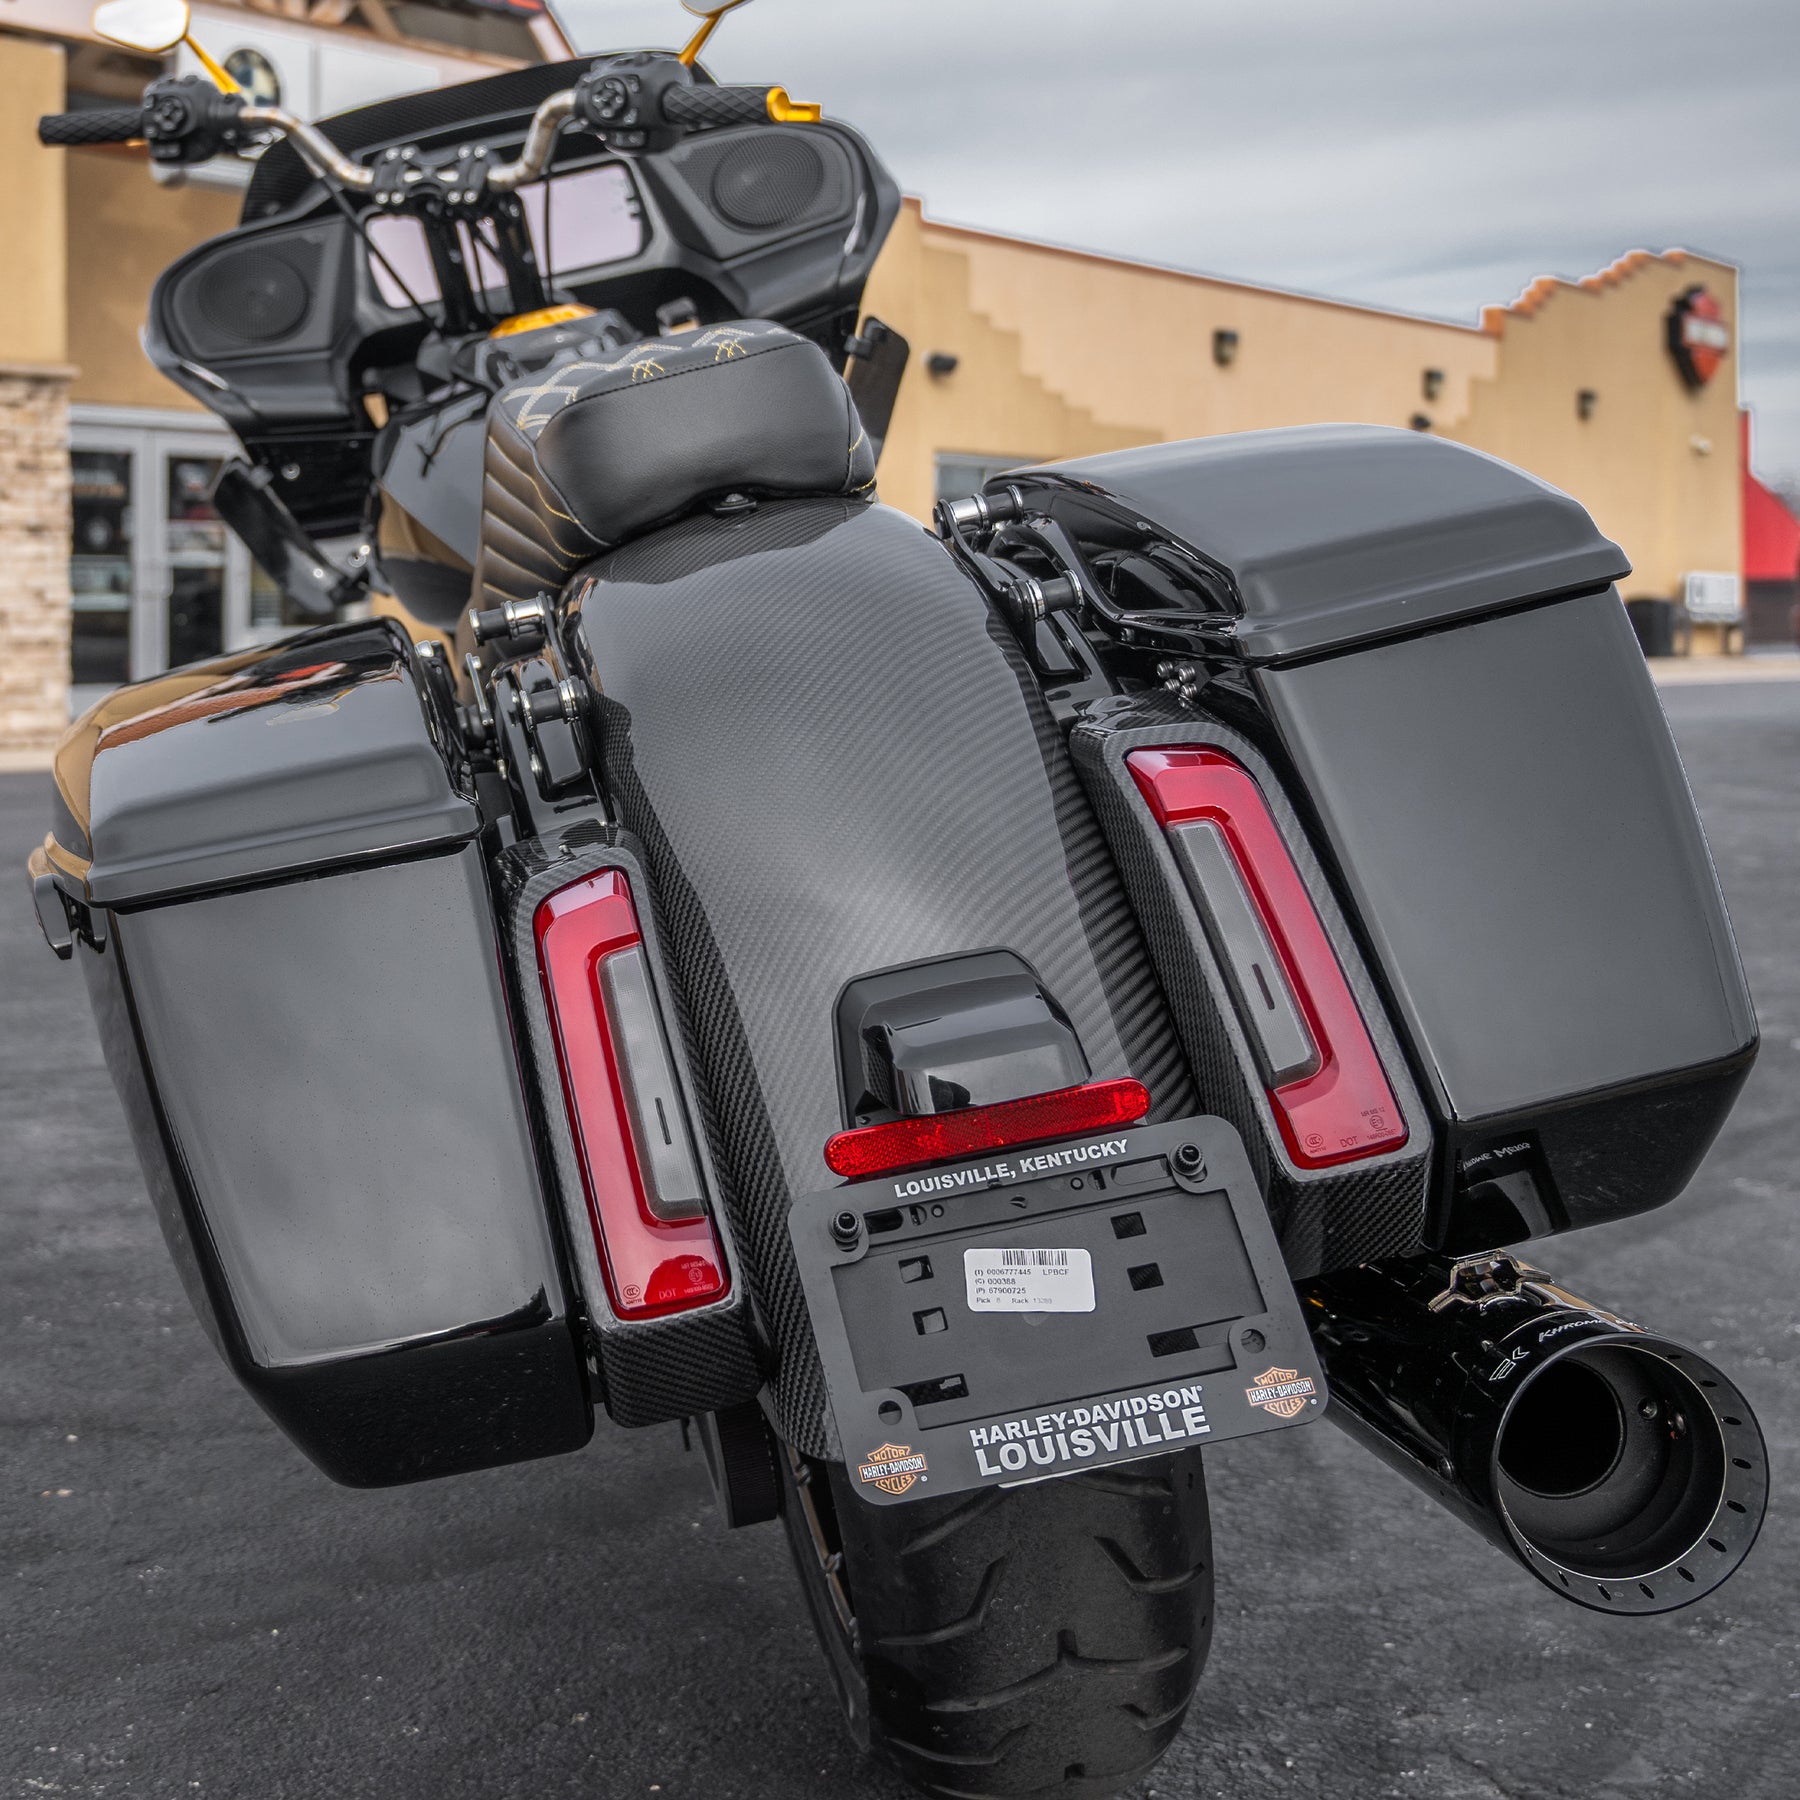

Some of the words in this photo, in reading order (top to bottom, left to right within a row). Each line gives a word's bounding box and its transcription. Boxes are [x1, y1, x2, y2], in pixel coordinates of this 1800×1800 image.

[1340, 1136, 1358, 1147] DOT
[894, 1163, 1016, 1198] LOUISVILLE,
[1019, 1139, 1128, 1173] KENTUCKY
[659, 1287, 677, 1299] DOT
[1261, 1371, 1293, 1385] MOTOR
[1250, 1380, 1312, 1402] HARLEY-DAVIDSON
[1268, 1398, 1301, 1414] CYCLES
[975, 1406, 1211, 1477] LOUISVILLE
[873, 1447, 905, 1461] MOTOR
[862, 1457, 924, 1479] HARLEY-DAVIDSON
[880, 1475, 912, 1491] CYCLES
